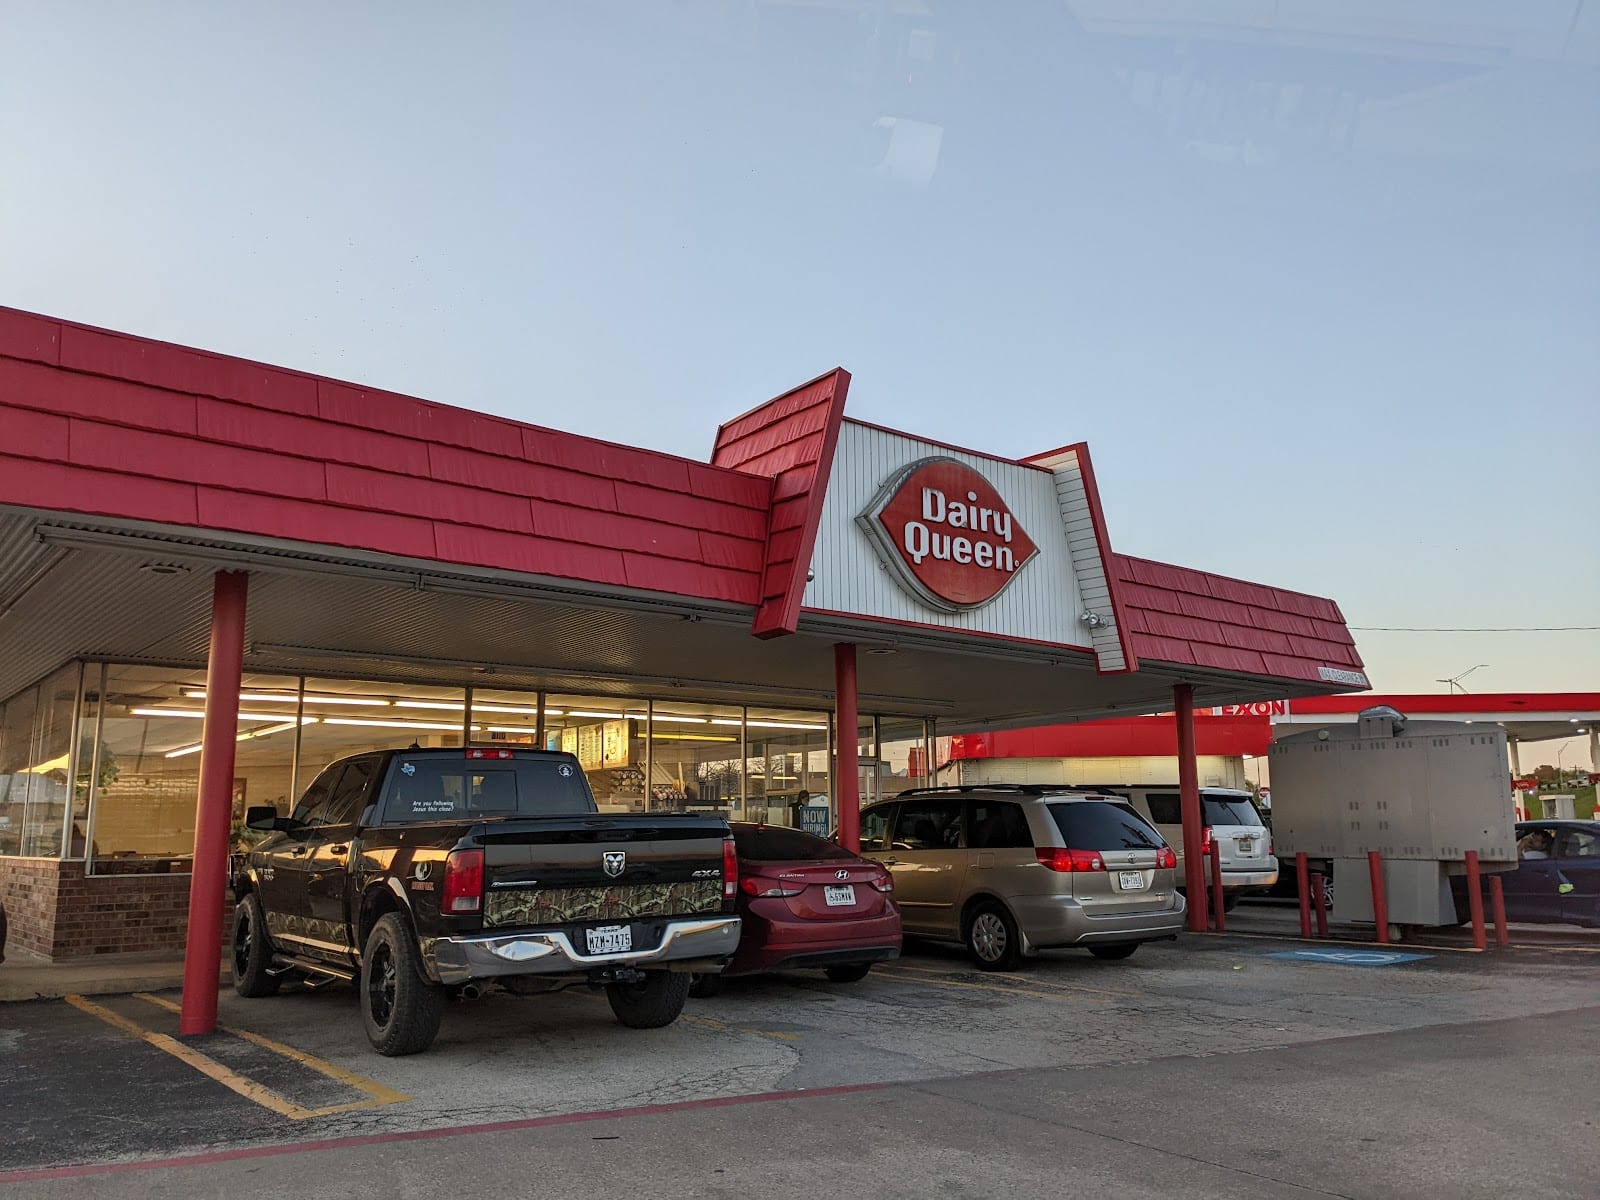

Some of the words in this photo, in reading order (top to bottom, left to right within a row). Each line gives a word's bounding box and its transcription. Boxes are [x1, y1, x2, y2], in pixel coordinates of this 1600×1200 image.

[922, 486, 1012, 543] Dairy
[903, 520, 1014, 572] Queen
[432, 800, 454, 808] following
[803, 810, 826, 823] NOW
